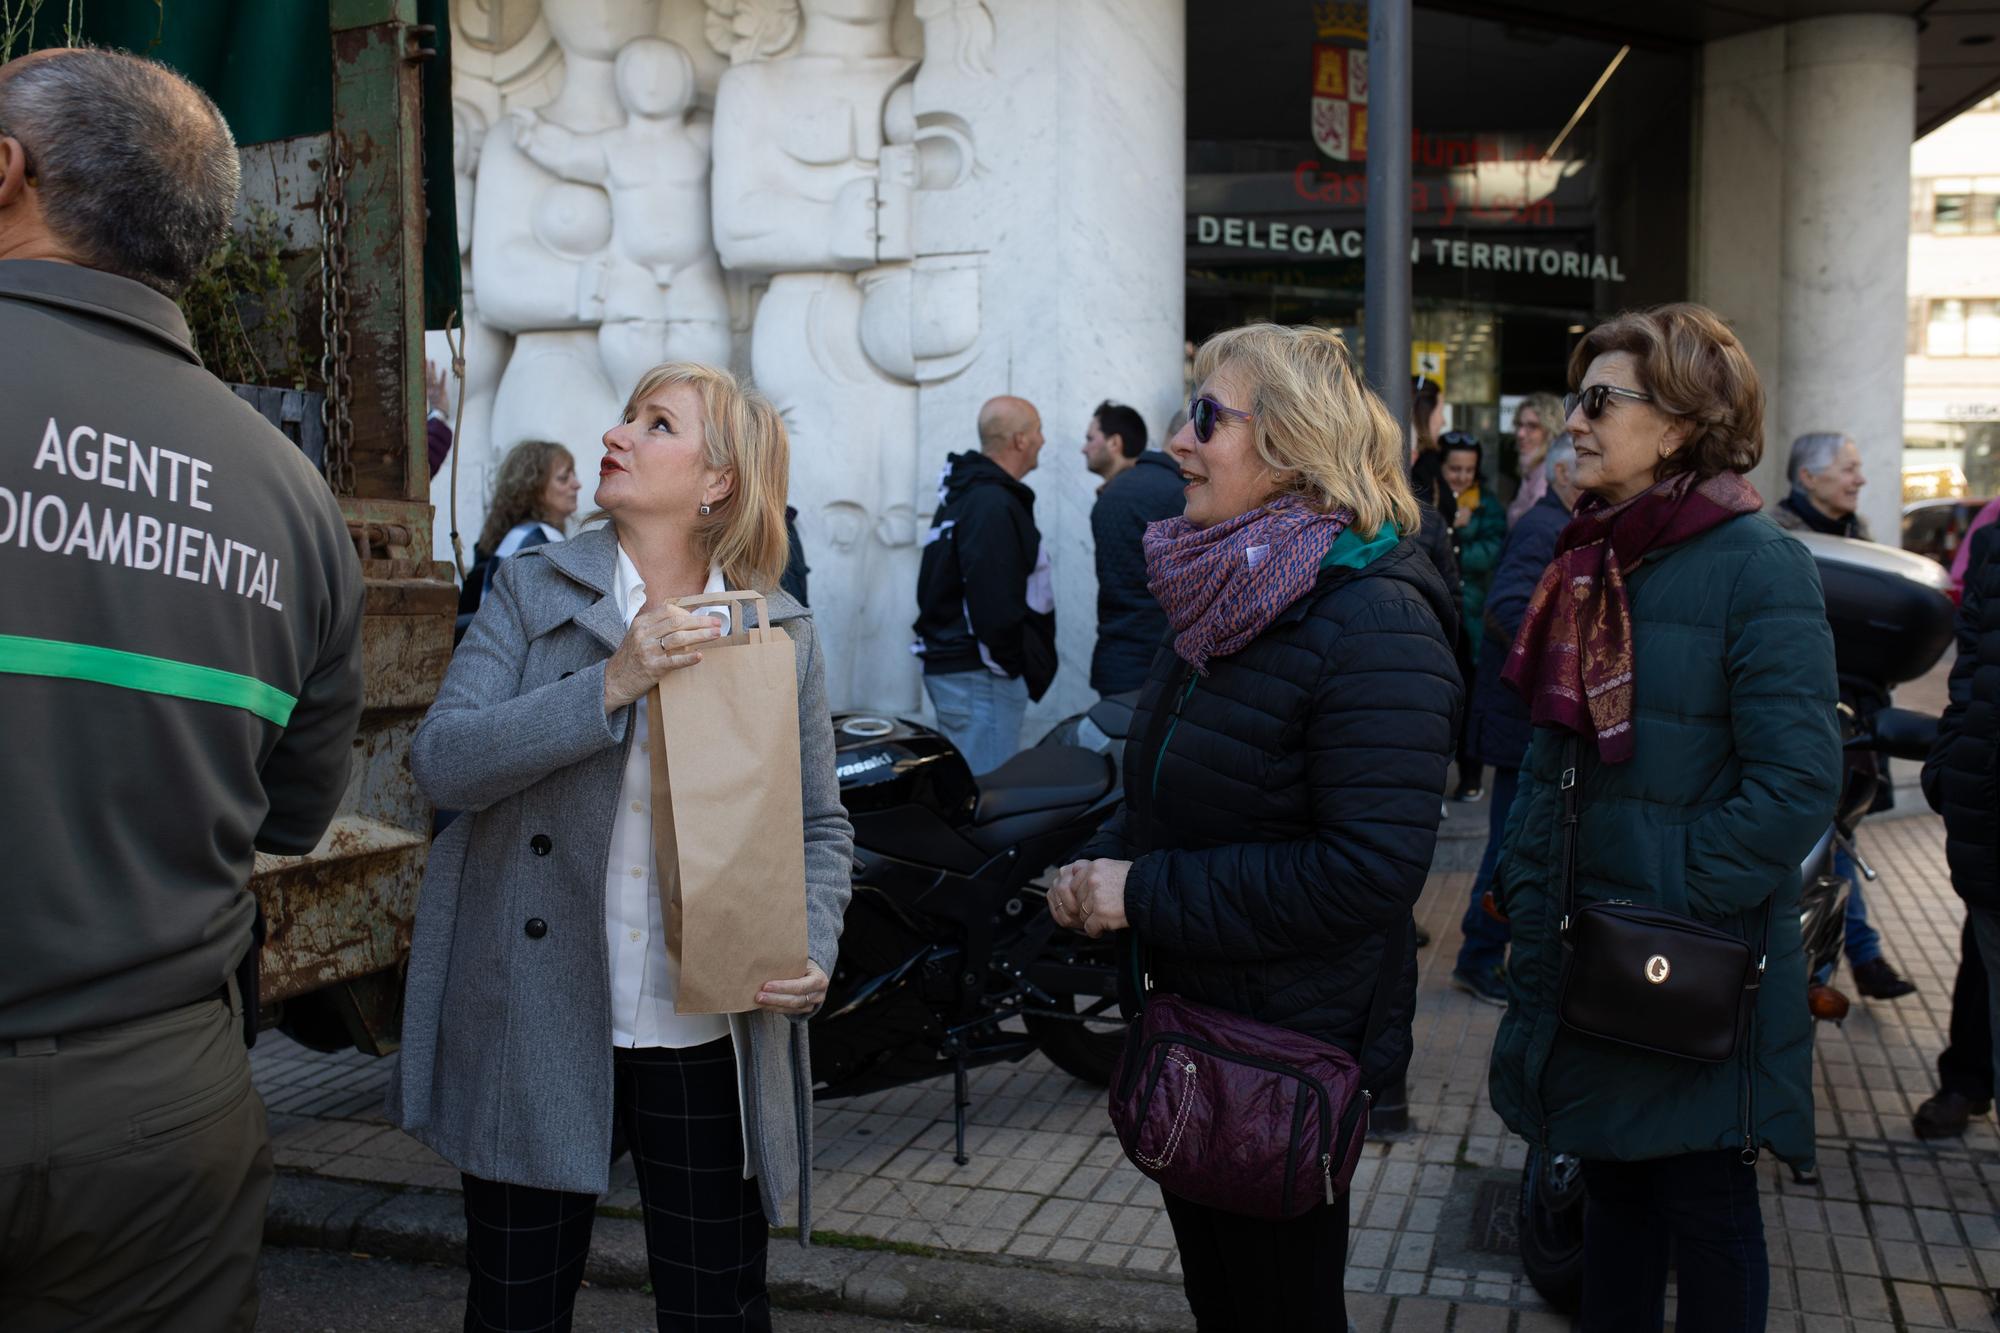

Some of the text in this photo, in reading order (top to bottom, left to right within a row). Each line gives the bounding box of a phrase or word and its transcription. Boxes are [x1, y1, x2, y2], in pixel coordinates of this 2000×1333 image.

[1440, 185, 1461, 227] y
[1197, 216, 1626, 282] DELEGAC TERRITORIAL
[33, 417, 213, 512] AGENTE
